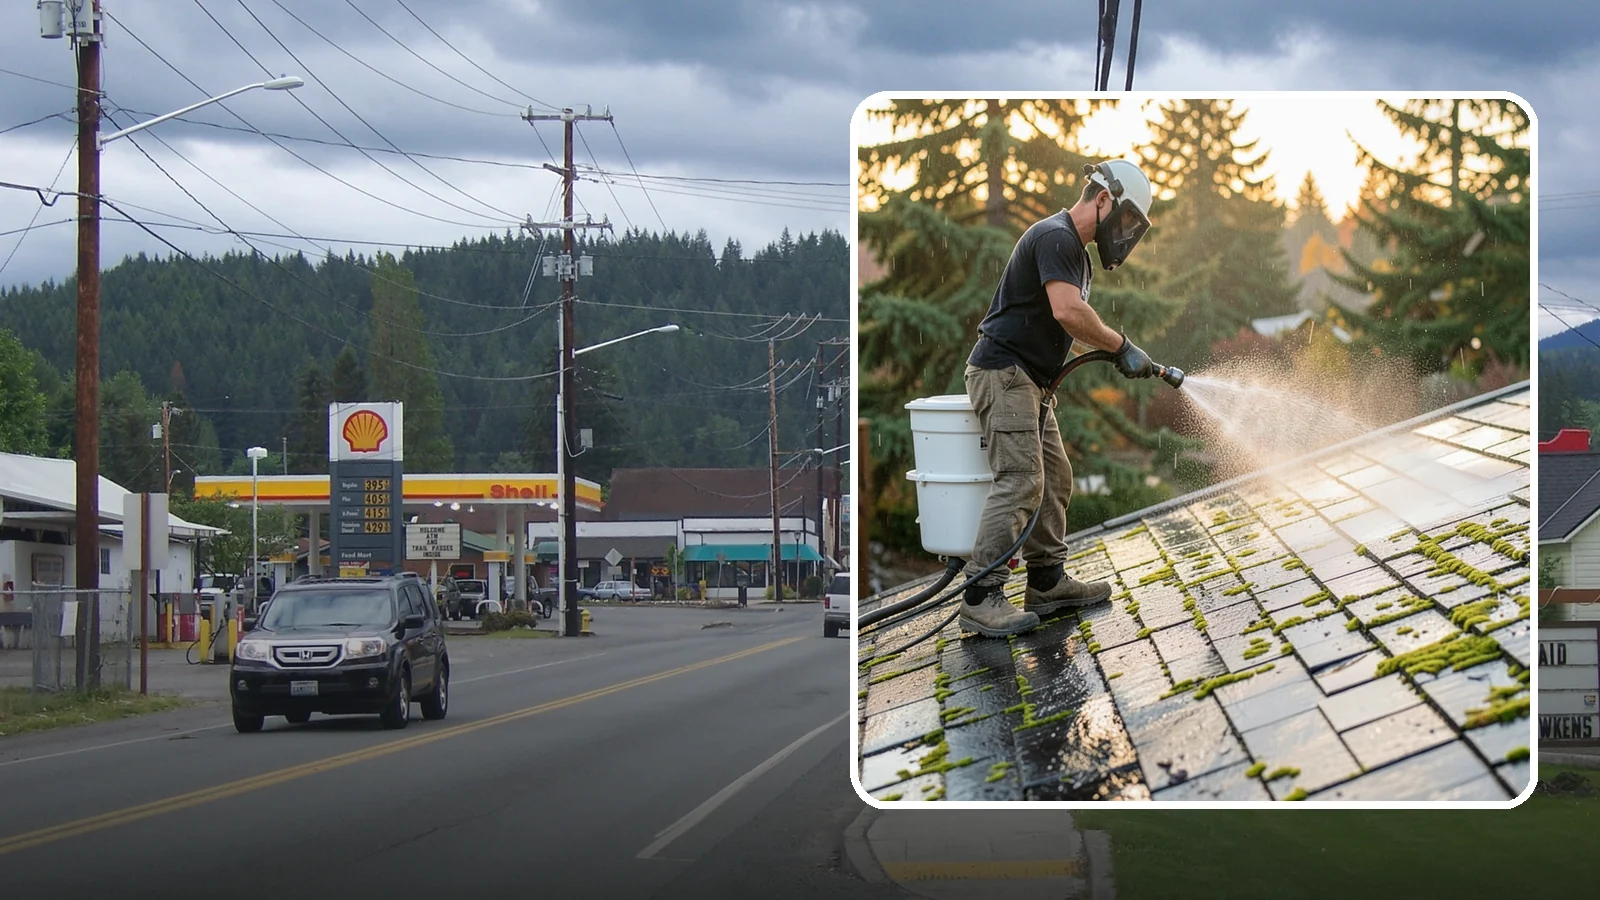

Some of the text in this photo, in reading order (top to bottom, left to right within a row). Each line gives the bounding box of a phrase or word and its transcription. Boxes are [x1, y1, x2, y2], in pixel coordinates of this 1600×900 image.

[366, 480, 383, 490] 395
[490, 484, 547, 499] Shell
[366, 494, 383, 504] 405
[366, 508, 383, 518] 415
[366, 522, 383, 532] 429
